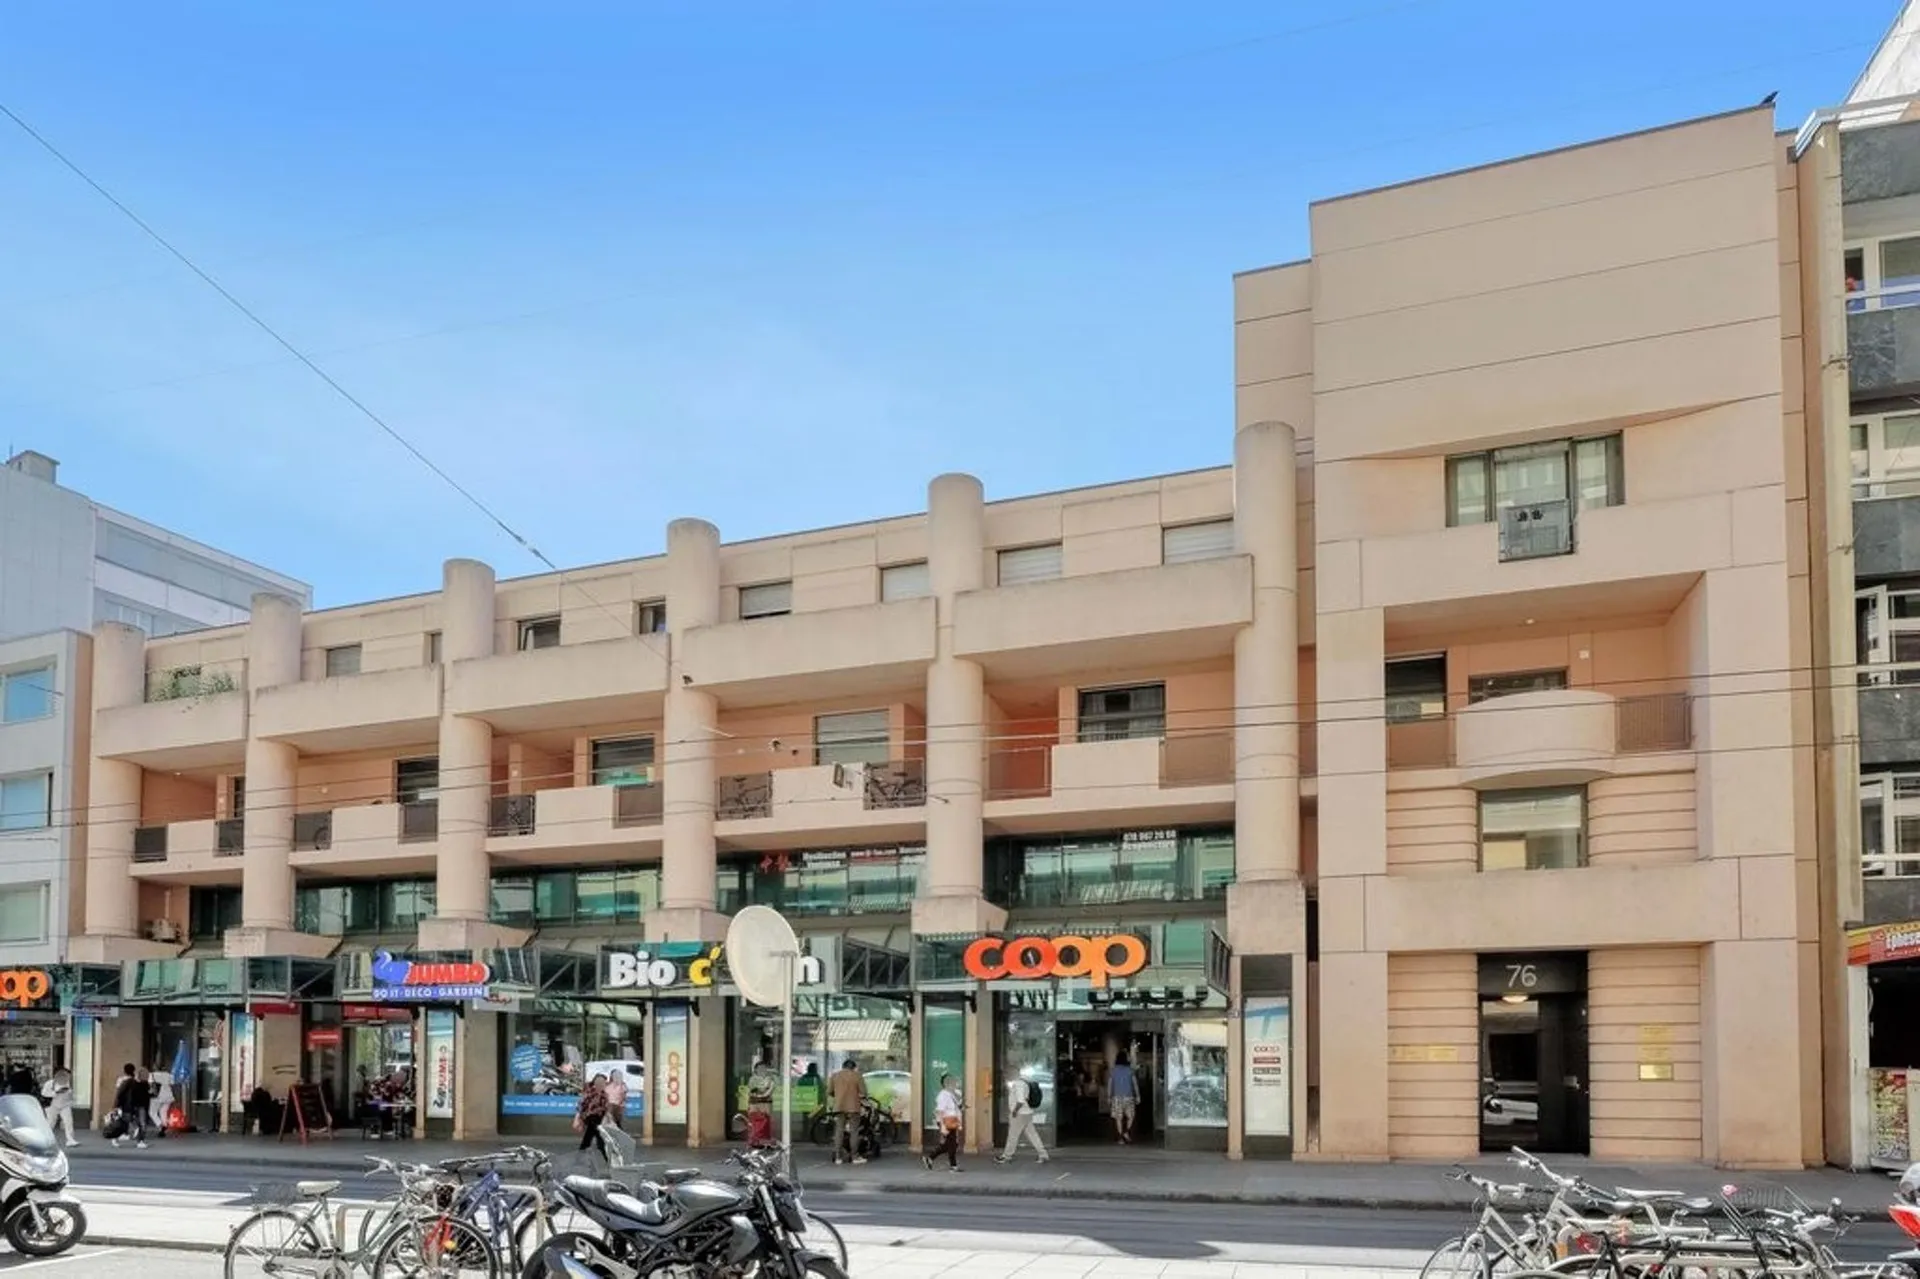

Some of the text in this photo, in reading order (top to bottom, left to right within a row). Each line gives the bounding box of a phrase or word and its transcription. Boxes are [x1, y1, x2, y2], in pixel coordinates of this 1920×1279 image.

[406, 961, 490, 985] JUMBO
[609, 950, 676, 987] Bio
[963, 934, 1147, 988] coop
[1505, 964, 1537, 988] 76
[0, 969, 48, 1008] op
[404, 987, 433, 998] DECO
[438, 985, 483, 997] GARDEN
